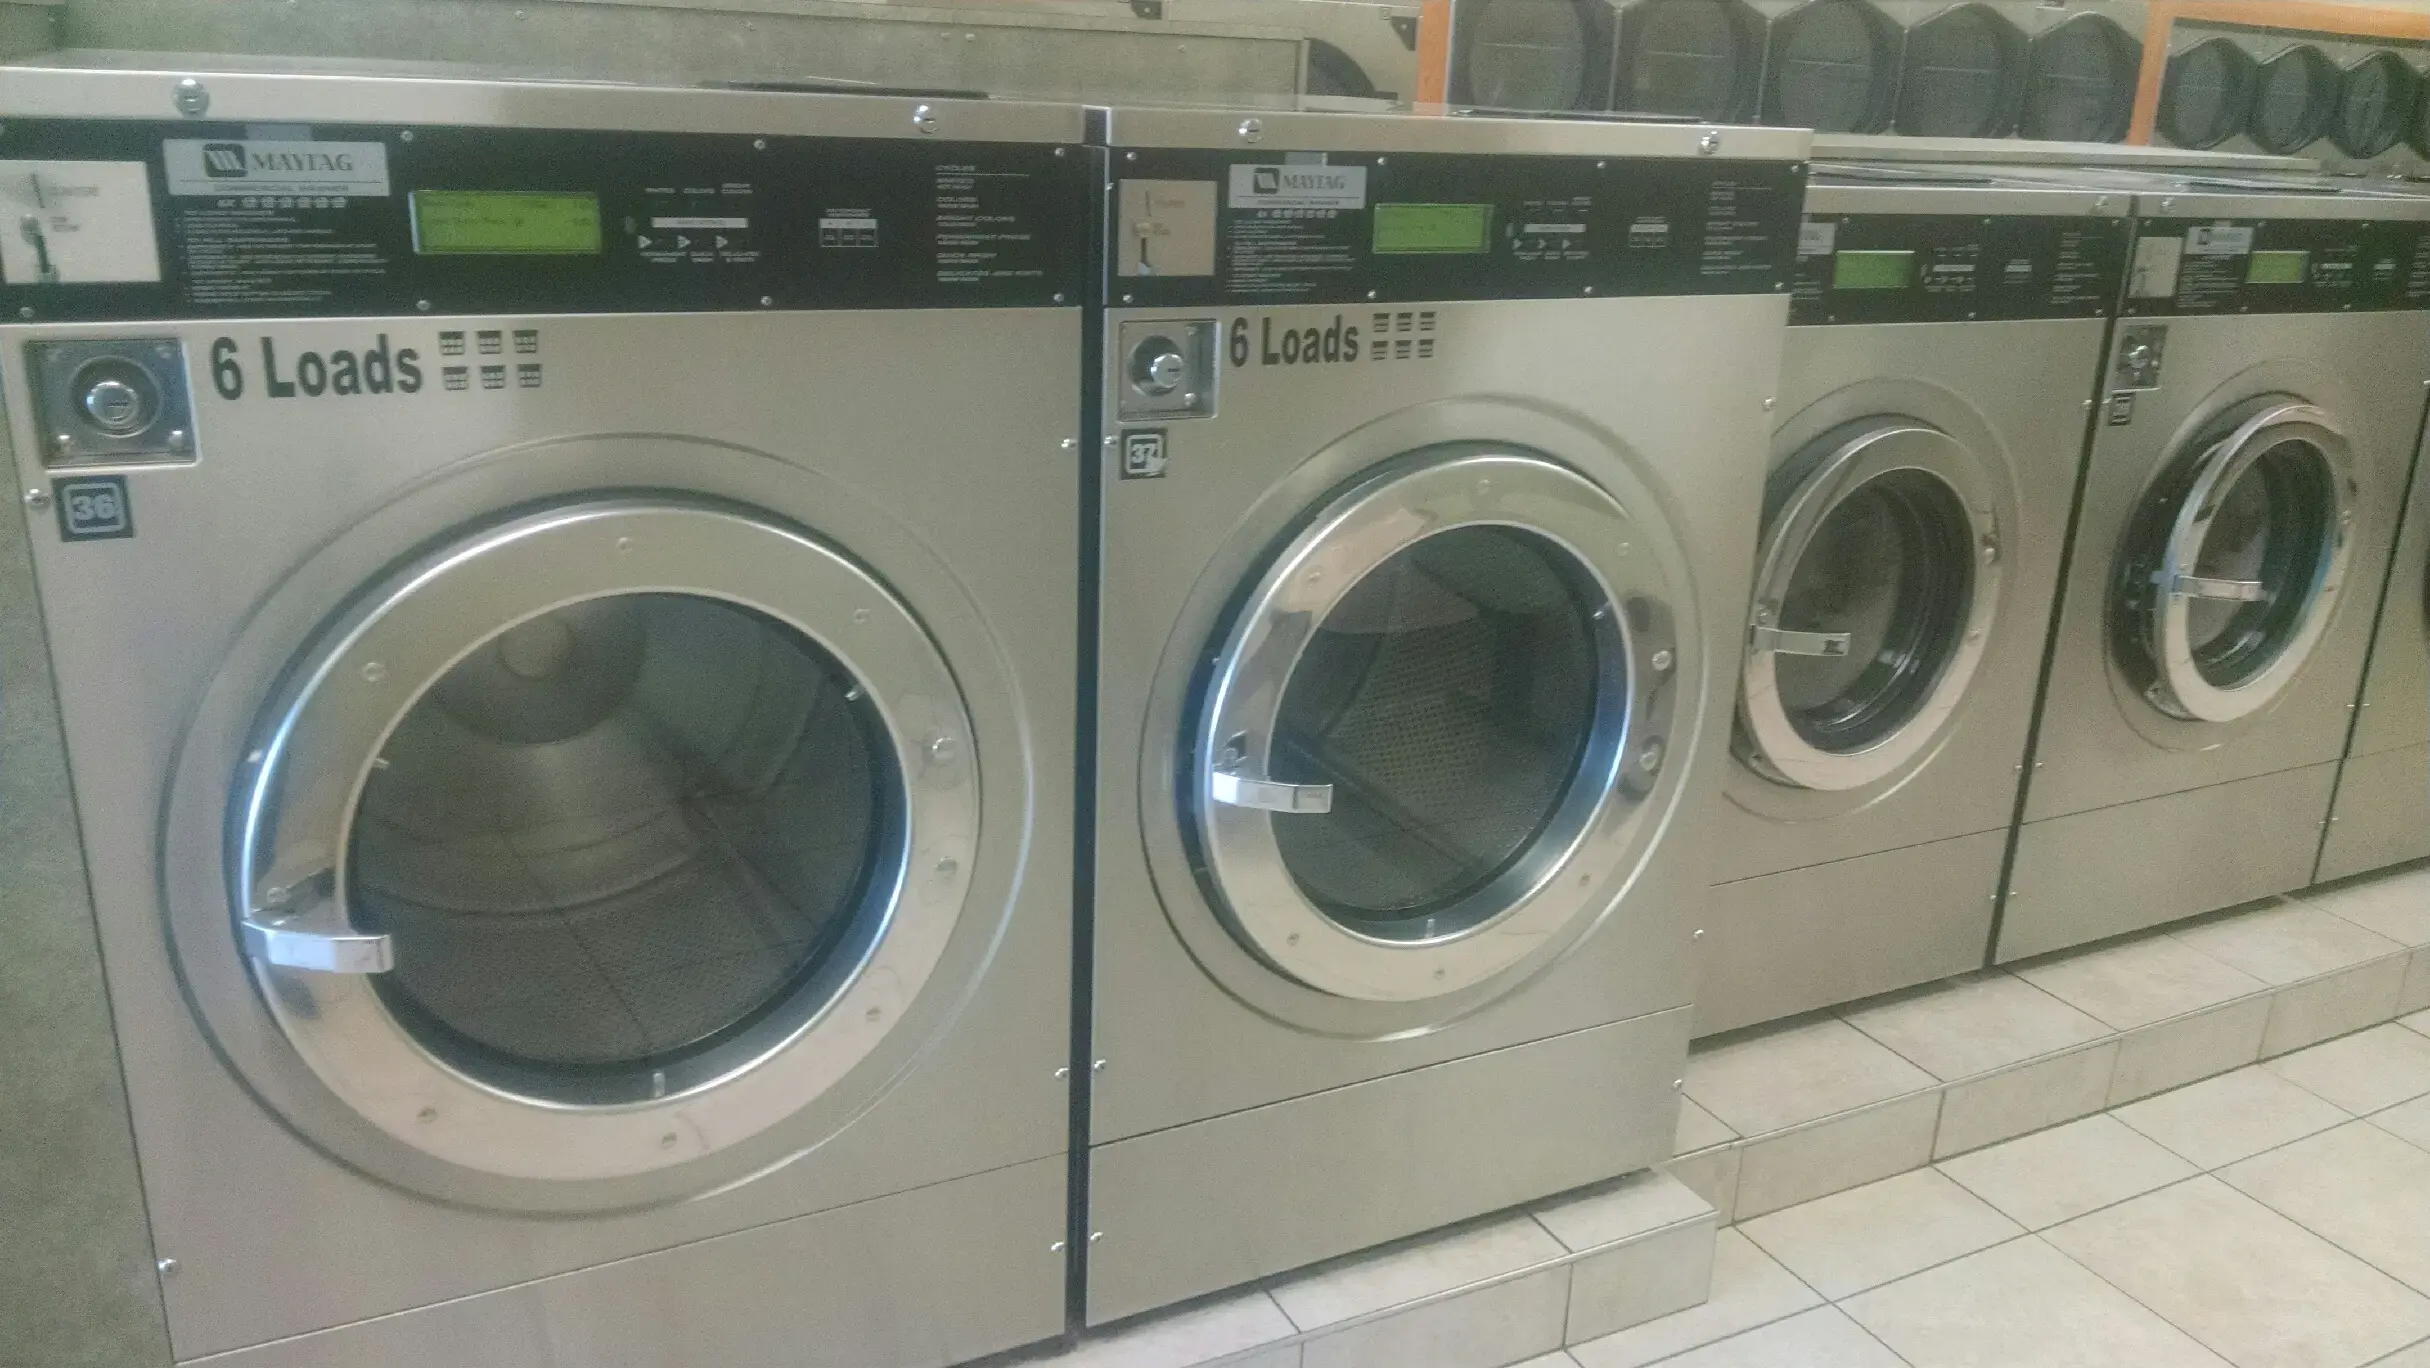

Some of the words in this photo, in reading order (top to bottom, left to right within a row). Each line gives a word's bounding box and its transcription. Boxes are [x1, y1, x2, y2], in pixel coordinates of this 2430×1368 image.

[251, 152, 354, 172] MAYTAG
[1282, 173, 1347, 190] MAYTAG
[1229, 316, 1249, 368] 6
[1260, 313, 1360, 366] Loads
[211, 335, 245, 401] 6
[259, 332, 424, 398] Loads
[1130, 443, 1157, 464] 37
[71, 493, 116, 520] 36
